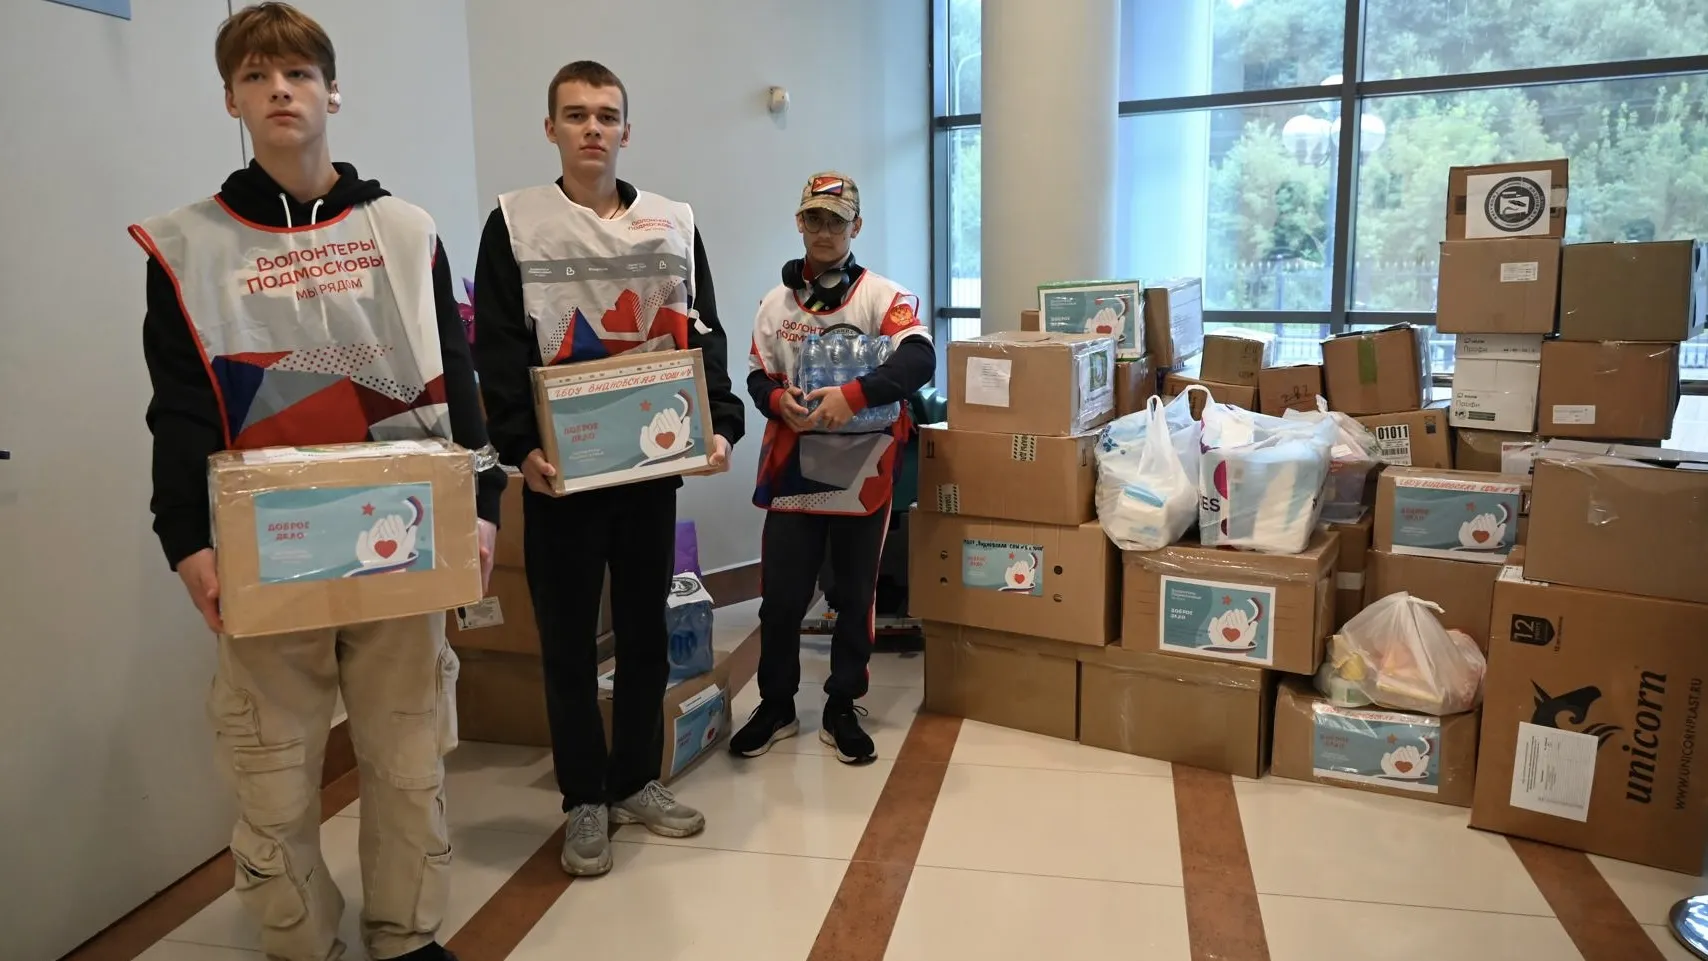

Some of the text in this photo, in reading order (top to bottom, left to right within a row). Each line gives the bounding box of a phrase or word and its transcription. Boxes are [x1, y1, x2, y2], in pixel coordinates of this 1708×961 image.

[256, 238, 376, 272] ВОЛОНТЕРЫ
[295, 277, 363, 301] МЫ РЯДОМ
[776, 329, 807, 342] ПОДМ
[782, 319, 825, 335] ВОЛОНТ
[1378, 425, 1408, 440] 01011
[268, 521, 310, 532] ДОБРОЕ
[276, 532, 305, 541] ДЕЛО
[1515, 619, 1535, 639] 12
[1622, 671, 1667, 804] unicorn
[1675, 678, 1703, 810] WWW.UNICORNPLAST.RU
